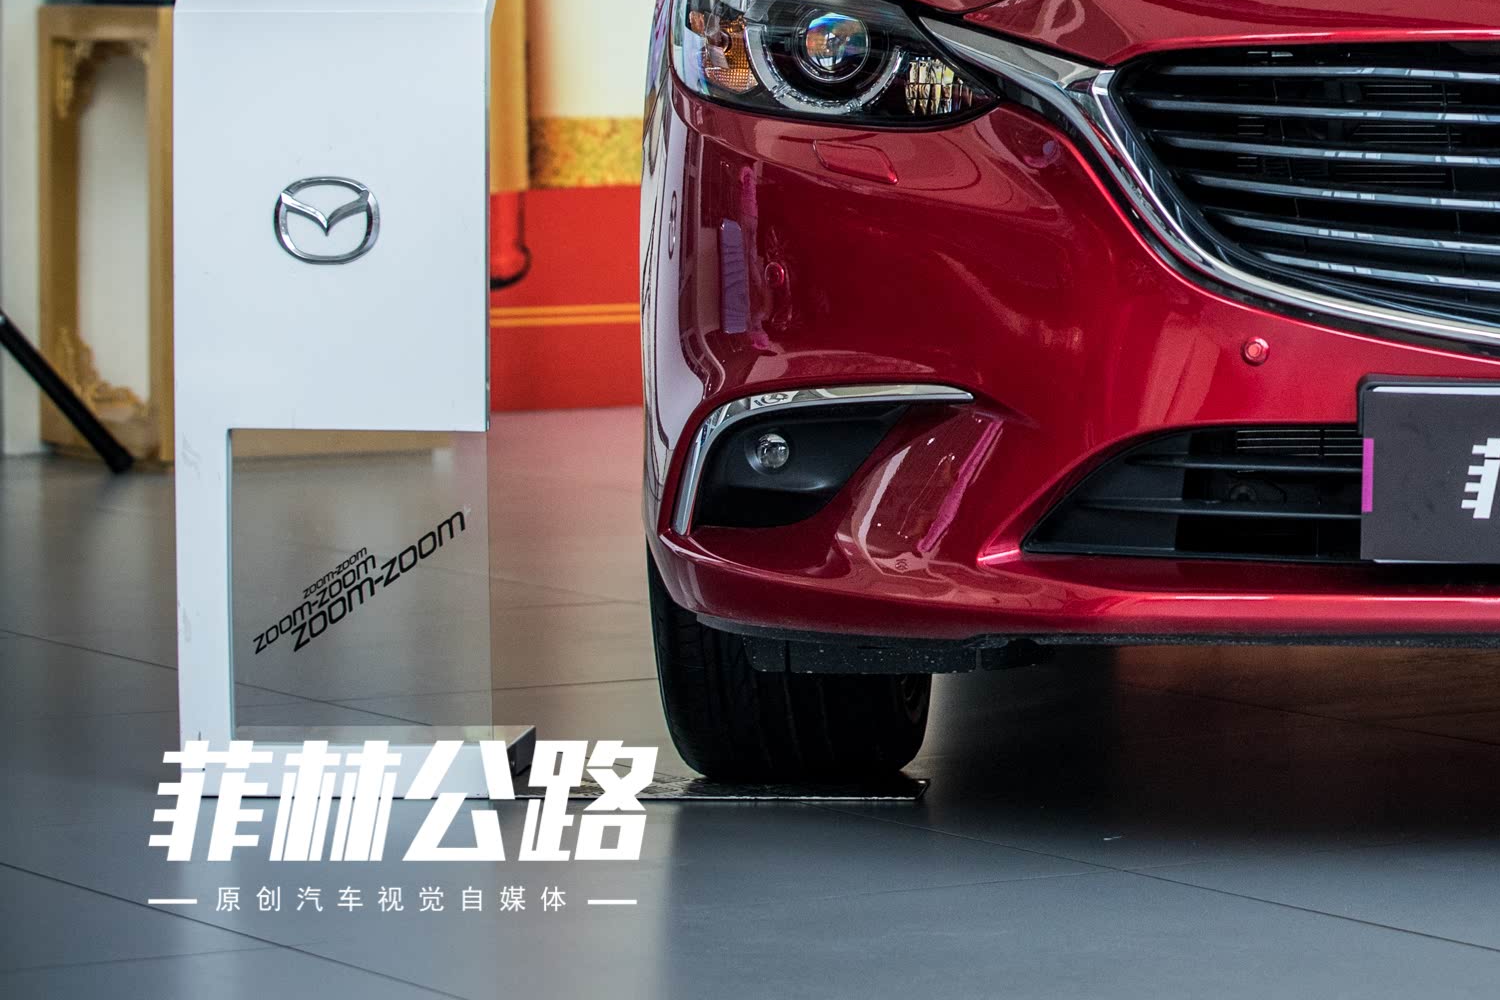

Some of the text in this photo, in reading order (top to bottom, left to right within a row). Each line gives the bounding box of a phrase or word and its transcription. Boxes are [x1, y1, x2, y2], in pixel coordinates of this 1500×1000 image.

[253, 555, 376, 654] zoom-zoom
[291, 511, 465, 652] zoom-zoom
[303, 547, 367, 599] zoom-zoom
